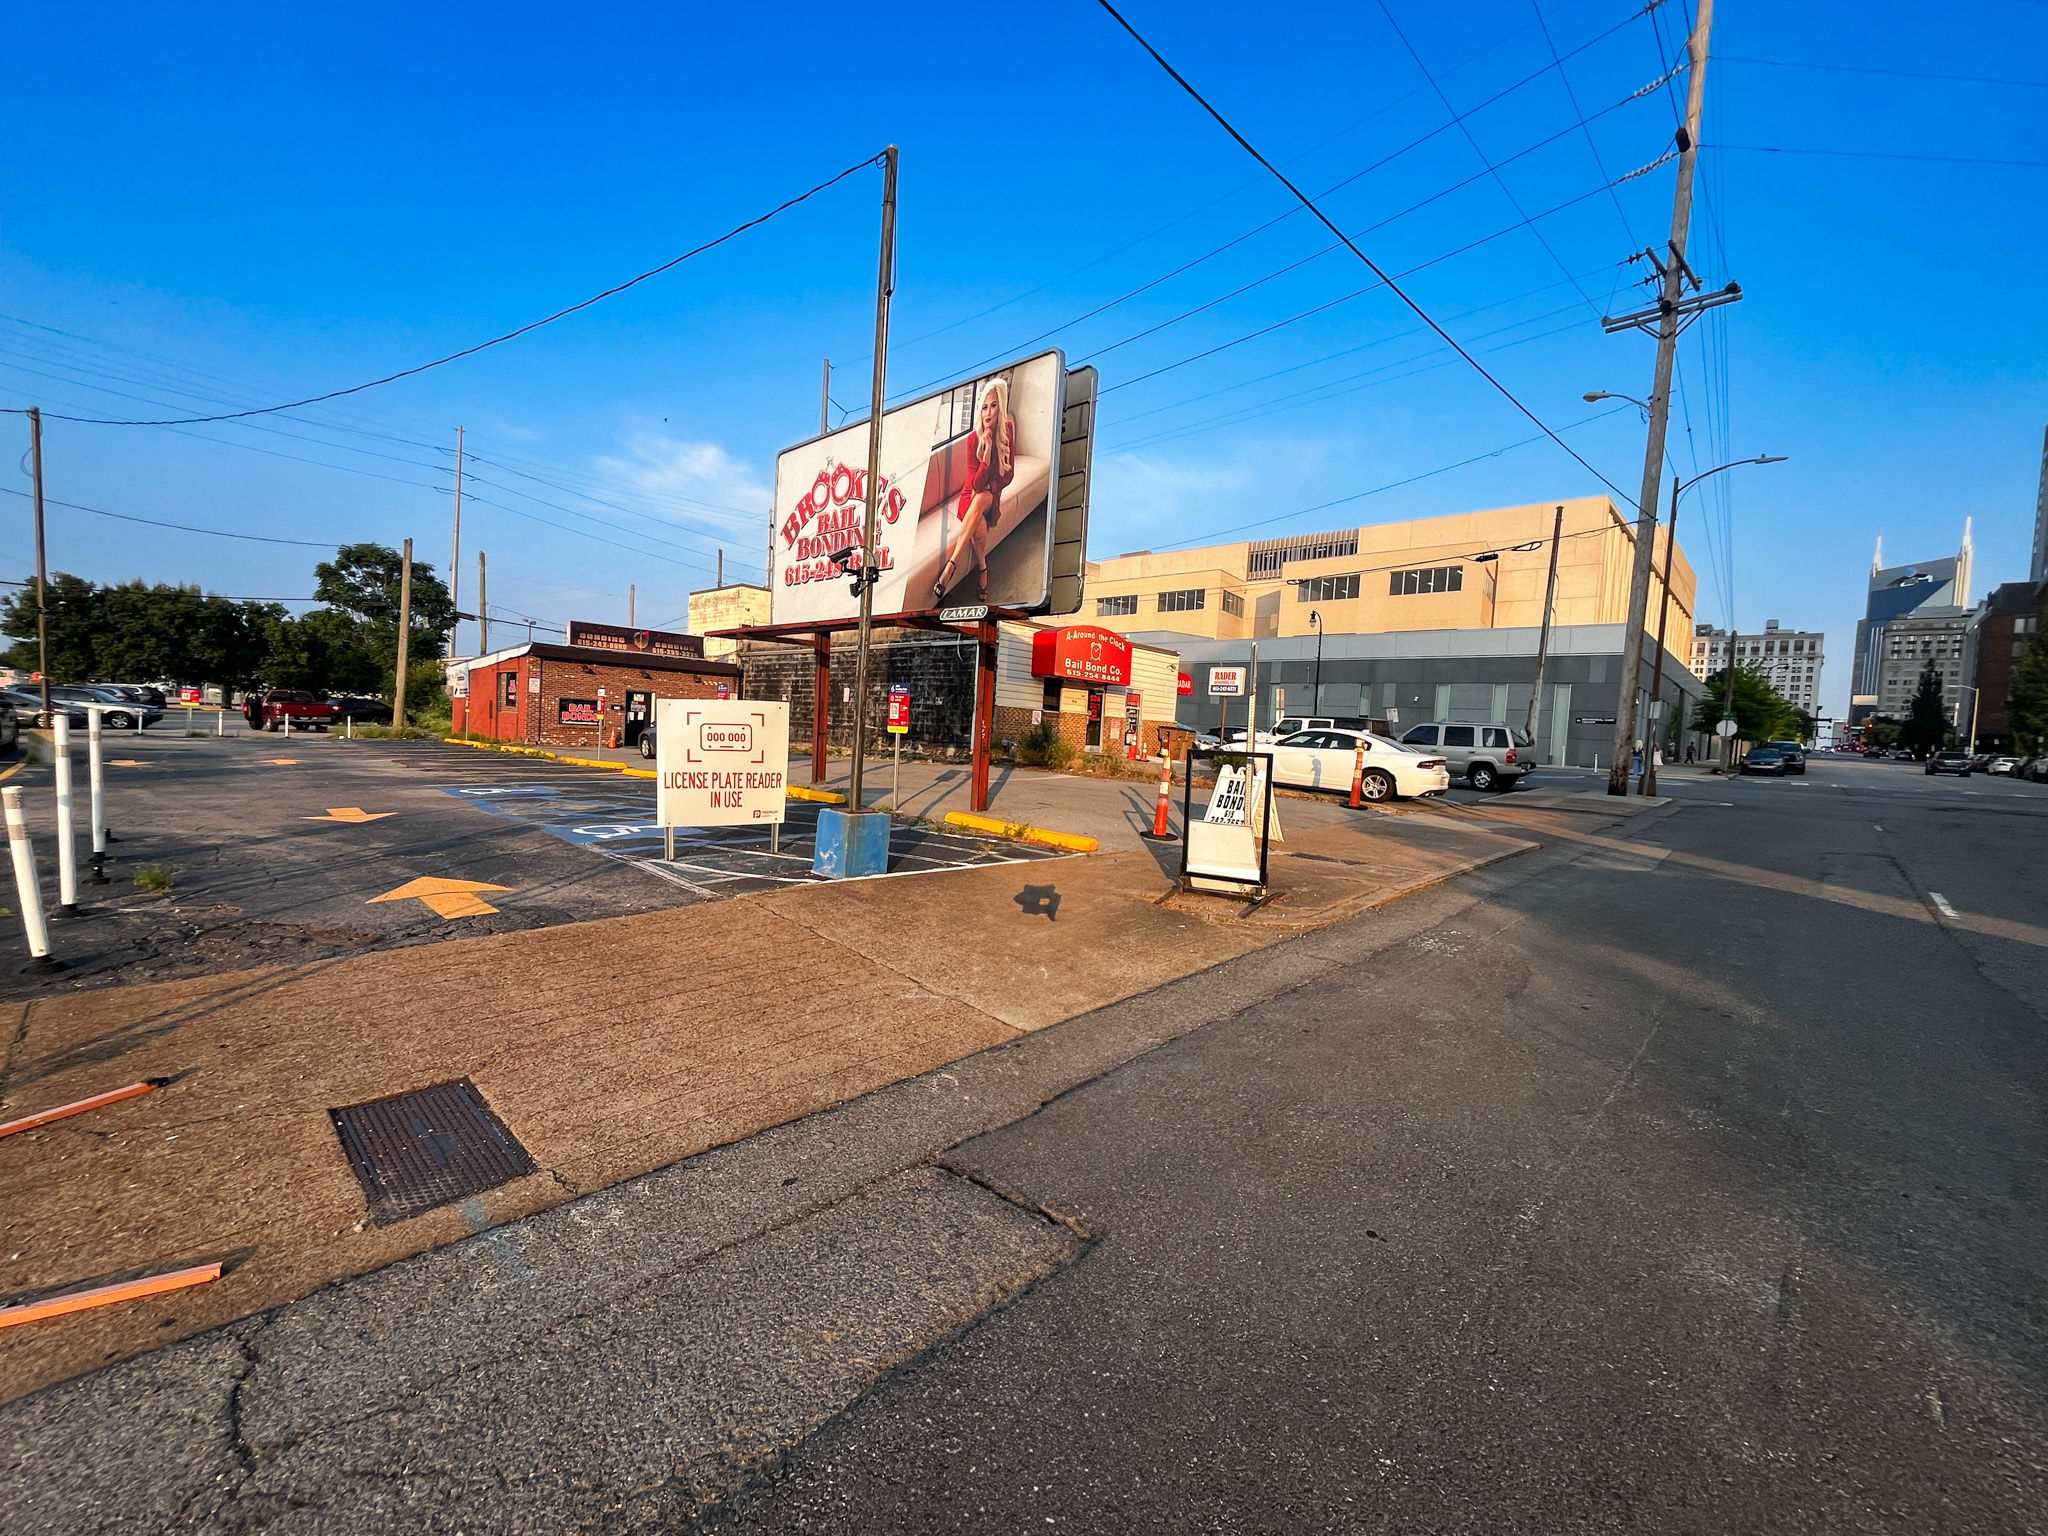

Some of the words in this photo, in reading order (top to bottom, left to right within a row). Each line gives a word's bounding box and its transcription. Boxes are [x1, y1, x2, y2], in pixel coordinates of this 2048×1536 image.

[816, 504, 860, 536] BAIL
[943, 607, 985, 619] LAMAR
[1065, 630, 1096, 641] A-Around
[1098, 633, 1109, 643] the
[1109, 636, 1126, 652] Clock
[1065, 658, 1083, 670] Bail
[1085, 661, 1107, 673] Bond
[1109, 665, 1123, 676] Co.
[1214, 671, 1237, 680] RADER
[1177, 680, 1191, 689] ADAR
[664, 772, 709, 789] LICENSE
[711, 772, 744, 789] PLATE
[745, 772, 782, 789] READER
[1226, 780, 1246, 796] BAI
[710, 791, 721, 808] IN
[724, 791, 743, 808] USE
[1216, 794, 1246, 812] BOND
[1223, 809, 1236, 819] 615
